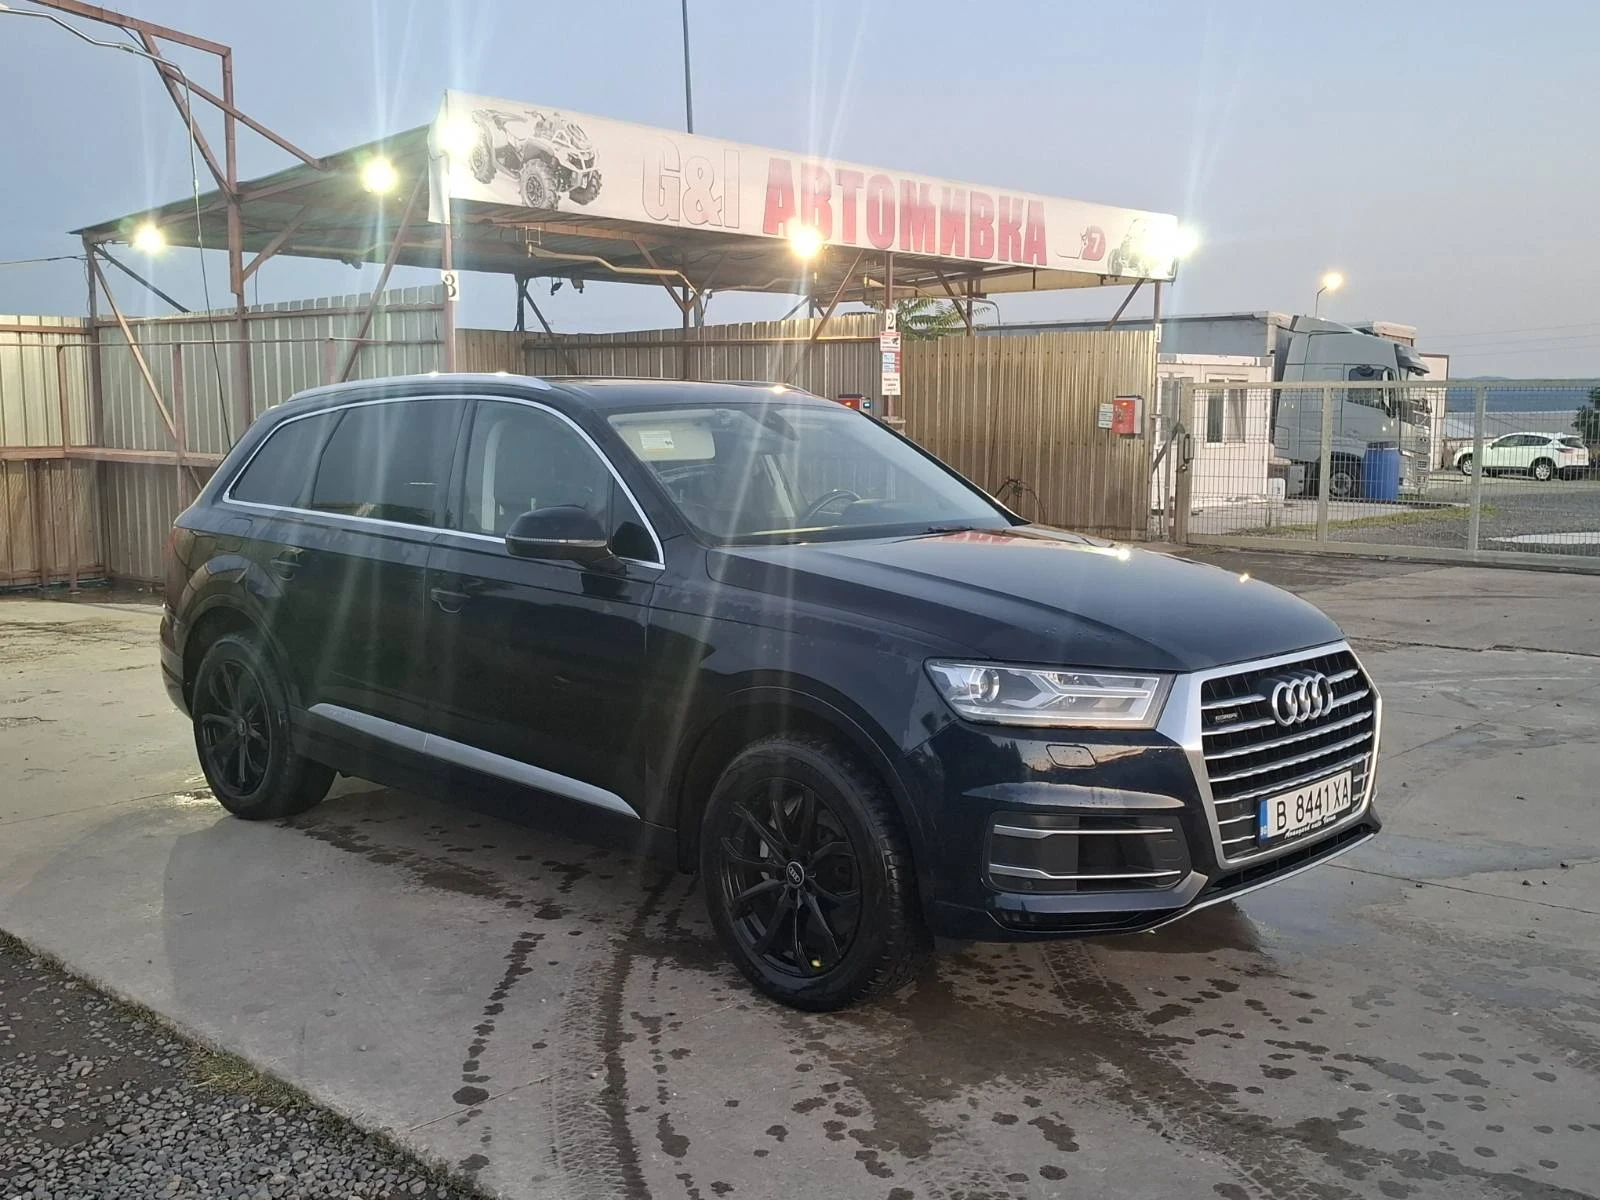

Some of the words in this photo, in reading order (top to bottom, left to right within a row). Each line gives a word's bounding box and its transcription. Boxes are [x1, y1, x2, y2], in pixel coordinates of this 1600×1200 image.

[763, 157, 1047, 265] АВТОМИВКА
[443, 274, 456, 297] 3
[887, 312, 895, 330] 2
[1277, 801, 1287, 830] B
[1296, 785, 1329, 822] 8441
